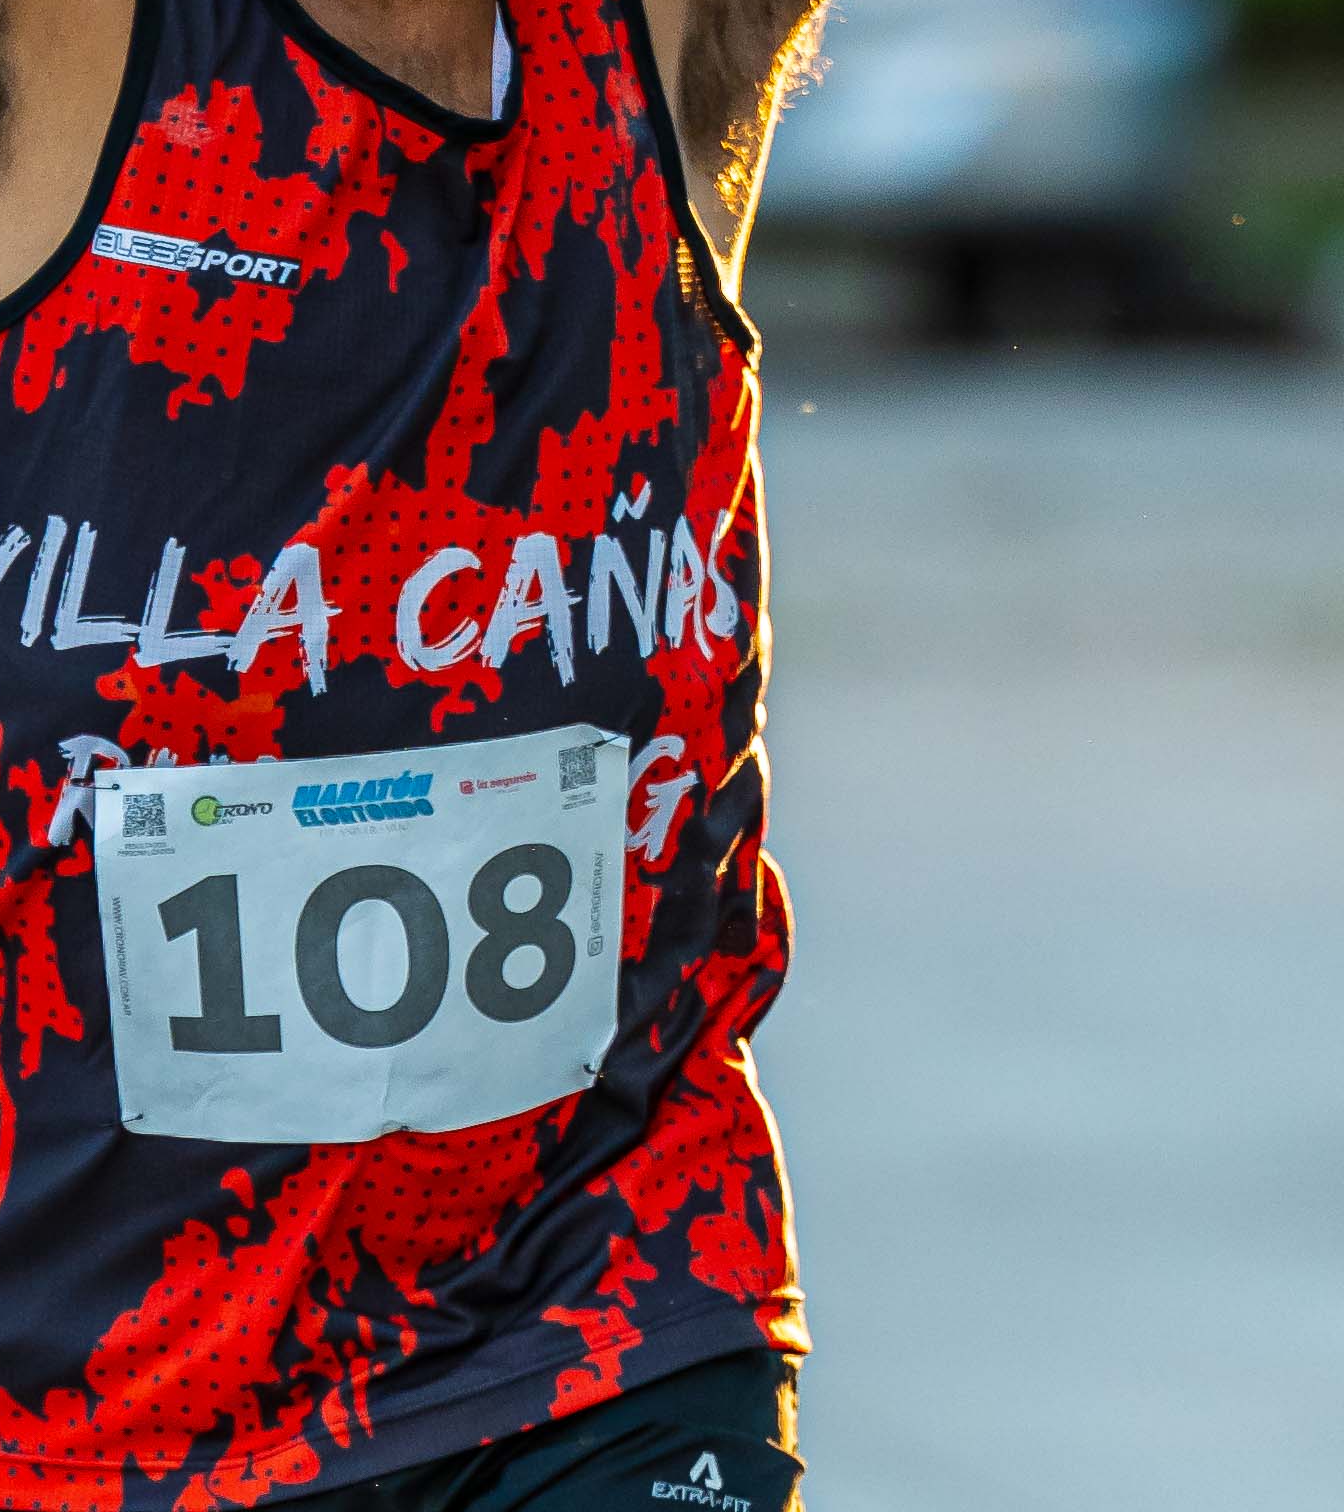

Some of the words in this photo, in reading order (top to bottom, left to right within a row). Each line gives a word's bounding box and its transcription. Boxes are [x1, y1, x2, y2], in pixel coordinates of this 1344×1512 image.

[395, 480, 740, 686] CAÑAS
[292, 769, 433, 809] MARATÓN
[157, 842, 576, 1053] 108
